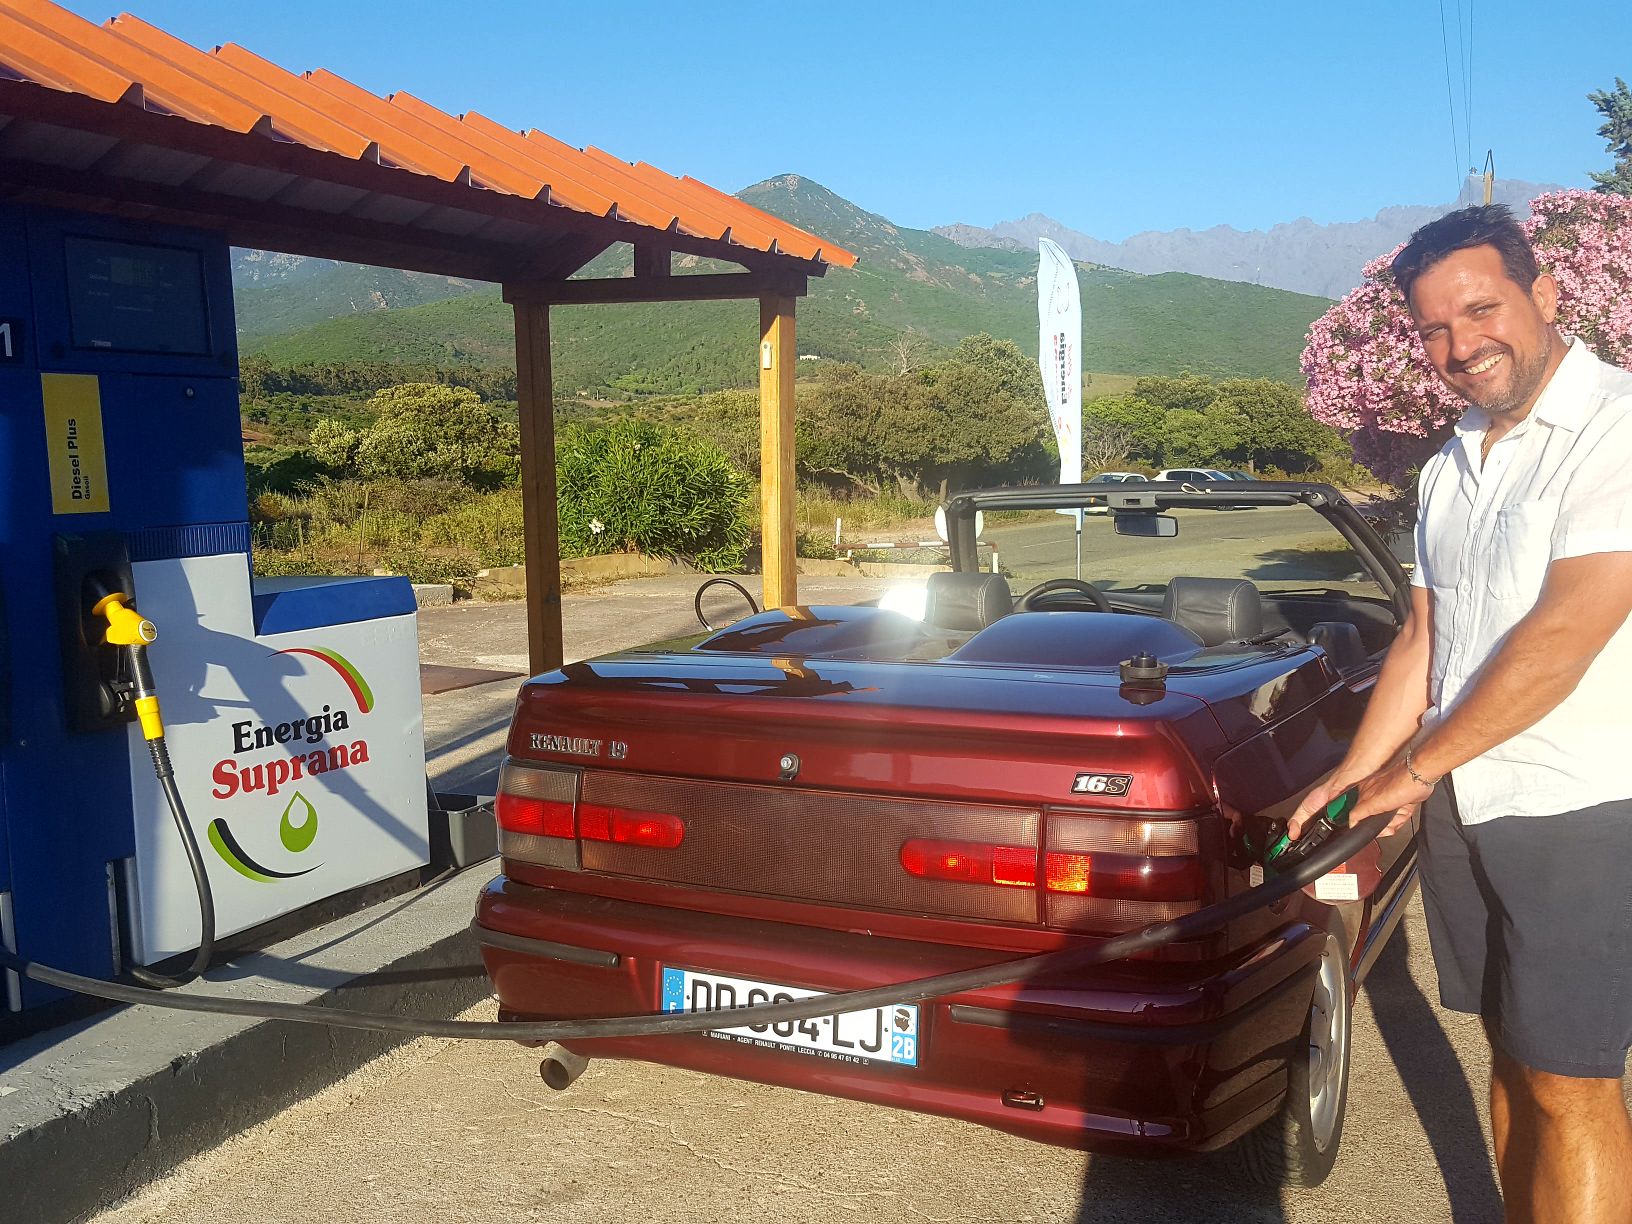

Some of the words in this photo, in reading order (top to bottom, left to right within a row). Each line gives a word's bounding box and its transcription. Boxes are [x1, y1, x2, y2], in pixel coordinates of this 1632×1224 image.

[67, 418, 79, 450] Plus
[69, 454, 82, 500] Diesel
[83, 475, 91, 500] Gasoil
[232, 704, 350, 754] Energia
[530, 733, 602, 756] RENAULT
[608, 740, 628, 759] 19
[212, 740, 370, 800] Suprana
[1074, 776, 1128, 793] 16S
[669, 1002, 676, 1014] F
[710, 1031, 731, 1041] MARIANI
[736, 1036, 753, 1045] AGENT
[754, 1039, 776, 1049] RENAULT
[779, 1042, 796, 1052] PONTE
[797, 1045, 815, 1056] LECCIA
[892, 1035, 915, 1059] 2B
